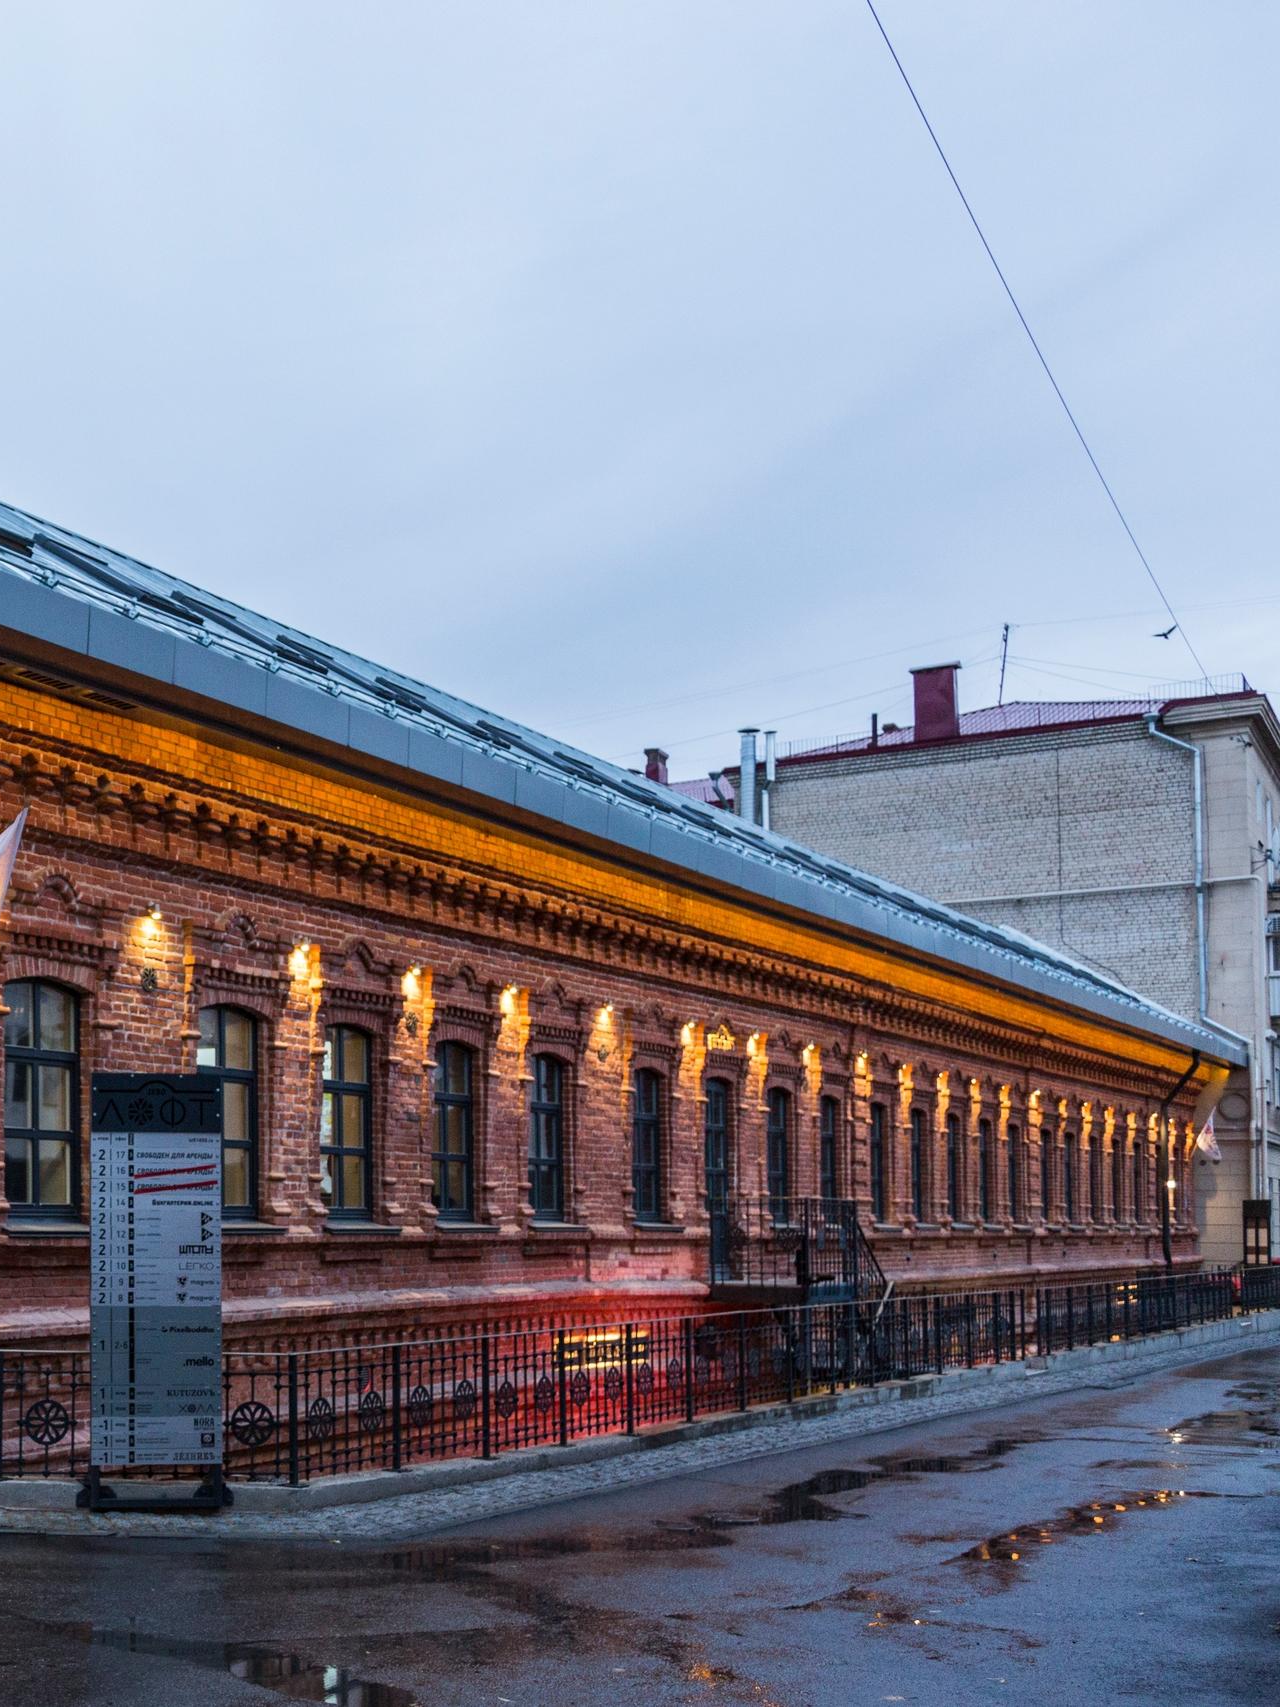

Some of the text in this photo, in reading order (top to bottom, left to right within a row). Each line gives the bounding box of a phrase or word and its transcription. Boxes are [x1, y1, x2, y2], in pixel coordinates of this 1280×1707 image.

[99, 1149, 106, 1160] 2
[116, 1151, 125, 1159] 17
[186, 1152, 214, 1160] АРЕНДЫ
[99, 1165, 106, 1176] 2
[99, 1181, 106, 1192] 2
[116, 1183, 125, 1191] 15
[99, 1197, 106, 1208] 2
[99, 1213, 106, 1224] 2
[99, 1229, 106, 1240] 2
[116, 1230, 126, 1238] 12
[99, 1245, 106, 1256] 2
[116, 1246, 125, 1254] 11
[99, 1260, 106, 1271] 2
[116, 1262, 126, 1270] 10
[99, 1277, 106, 1287] 2
[119, 1278, 124, 1286] 9
[99, 1292, 106, 1304] 2
[118, 1294, 123, 1302] 8
[100, 1340, 105, 1350] 1
[100, 1388, 105, 1399] 1
[100, 1404, 105, 1415] 1
